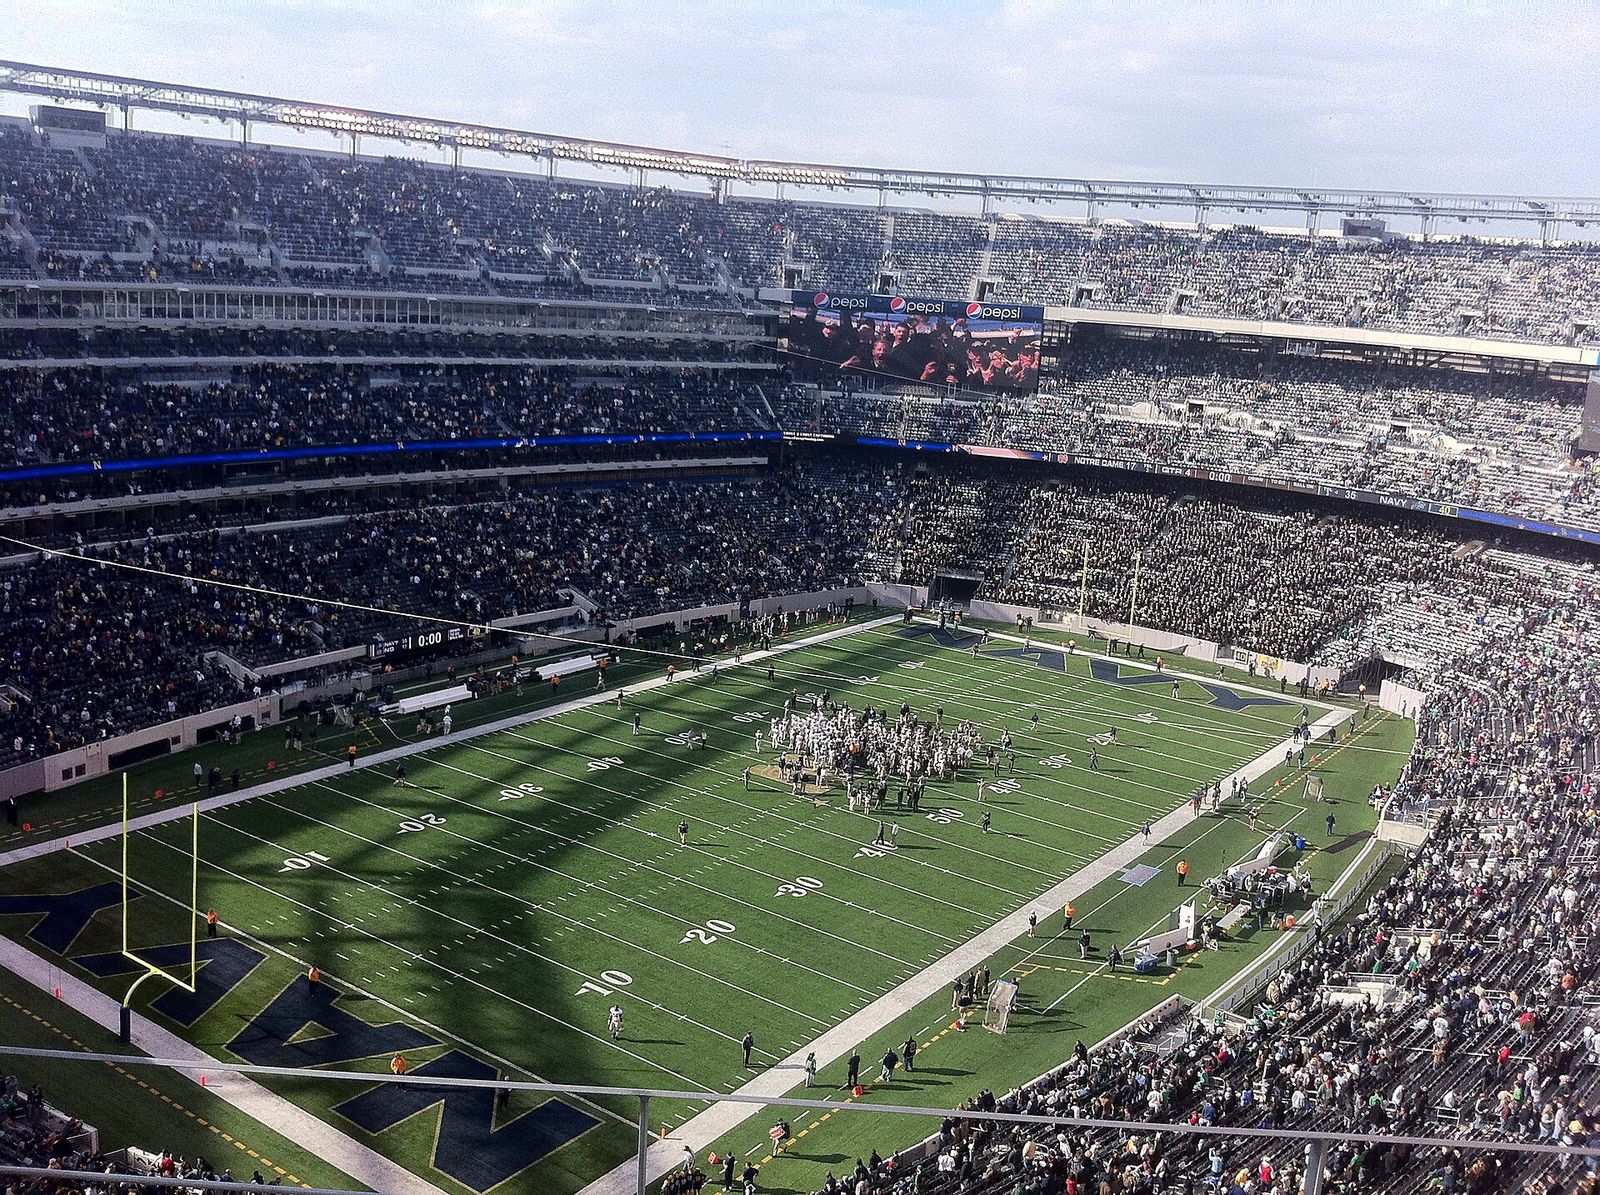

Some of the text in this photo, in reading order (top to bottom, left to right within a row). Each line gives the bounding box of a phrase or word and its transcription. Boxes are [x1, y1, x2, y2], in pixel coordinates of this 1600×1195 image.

[831, 297, 868, 309] pepsi
[907, 301, 944, 315] pepsi
[982, 306, 1020, 321] pepsi
[1074, 457, 1100, 466] NOTRE
[1101, 459, 1124, 469] DAME
[1126, 462, 1136, 471] 17
[1185, 469, 1191, 477] 4
[1209, 472, 1231, 482] 0:00
[1344, 490, 1356, 499] 35
[1379, 496, 1407, 507] NAVY
[1438, 505, 1450, 514] 40
[418, 632, 441, 647] 0:00
[587, 757, 624, 770] 40
[1039, 755, 1072, 769] 30
[500, 783, 544, 799] 30
[988, 780, 1021, 794] 40
[400, 814, 446, 831] 20
[925, 808, 964, 824] 50
[859, 839, 898, 857] 40
[283, 851, 330, 870] 10
[778, 876, 823, 897] 30
[686, 920, 735, 945] 20
[581, 970, 633, 997] 10
